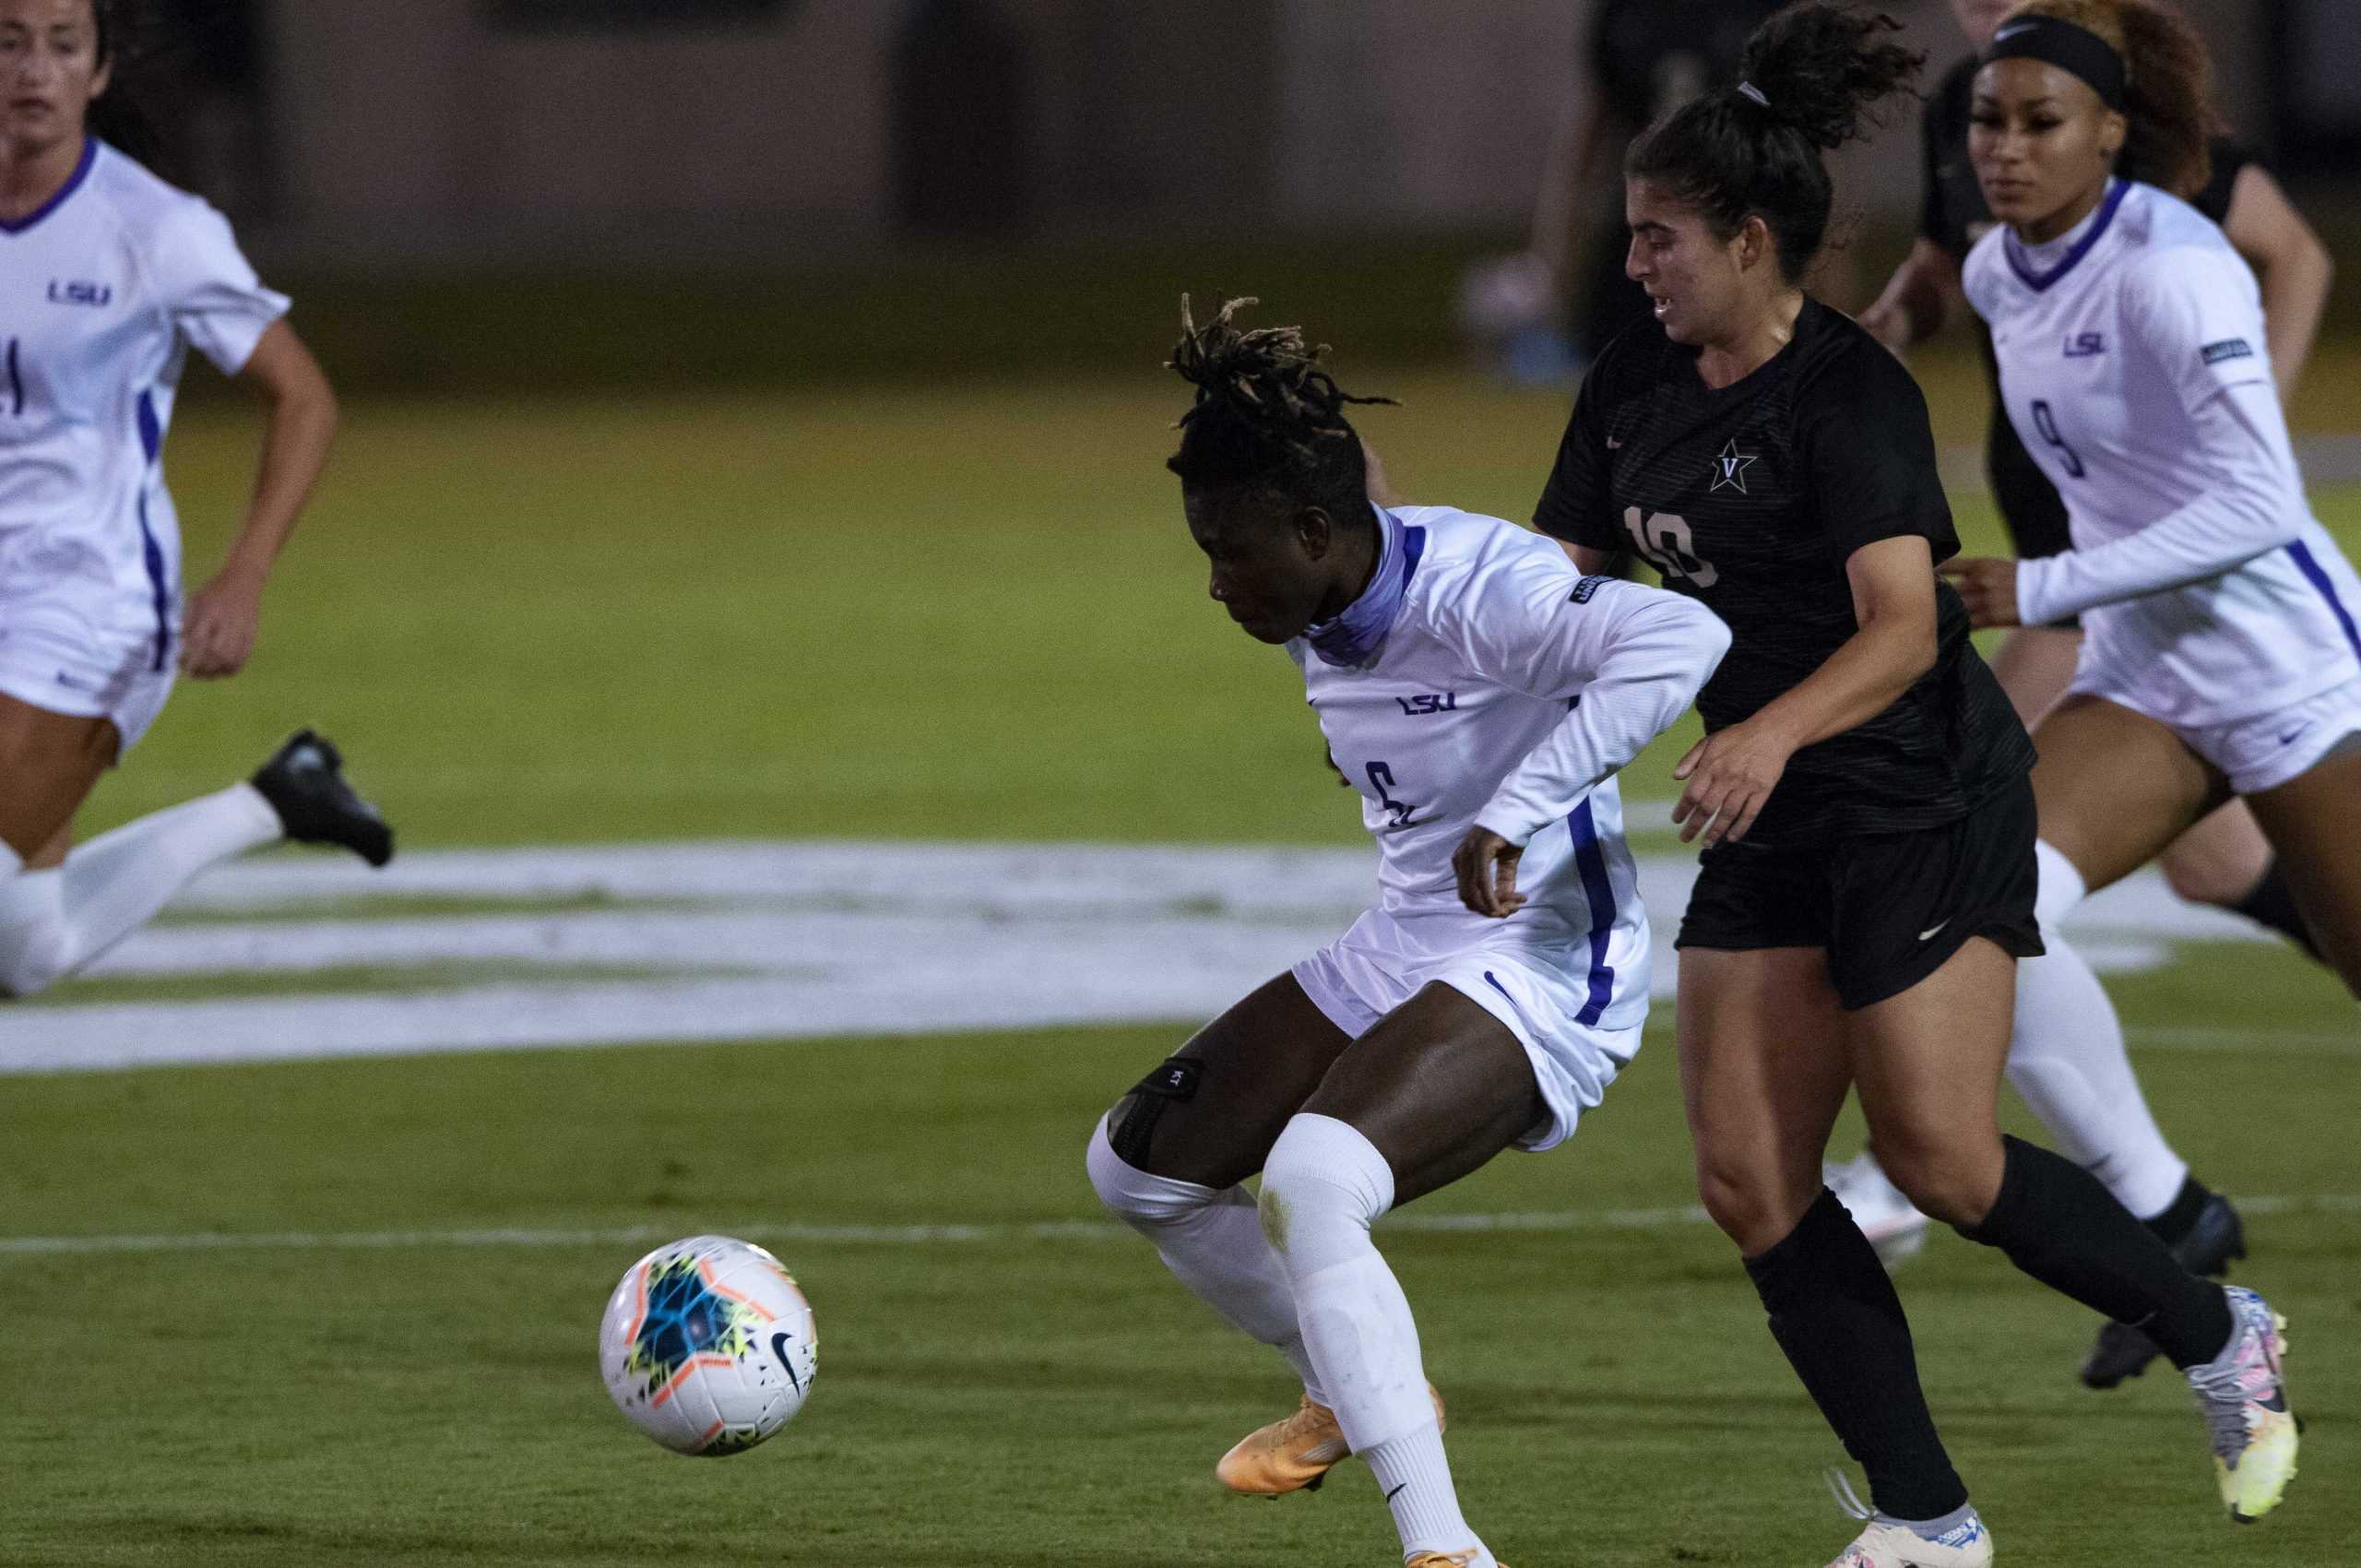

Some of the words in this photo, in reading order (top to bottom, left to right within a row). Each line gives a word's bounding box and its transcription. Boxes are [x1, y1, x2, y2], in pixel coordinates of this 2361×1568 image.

[49, 279, 112, 306] LSU
[2032, 399, 2085, 479] 9
[1722, 457, 1740, 479] V
[1623, 505, 1720, 588] 10
[1395, 692, 1457, 716] LSU
